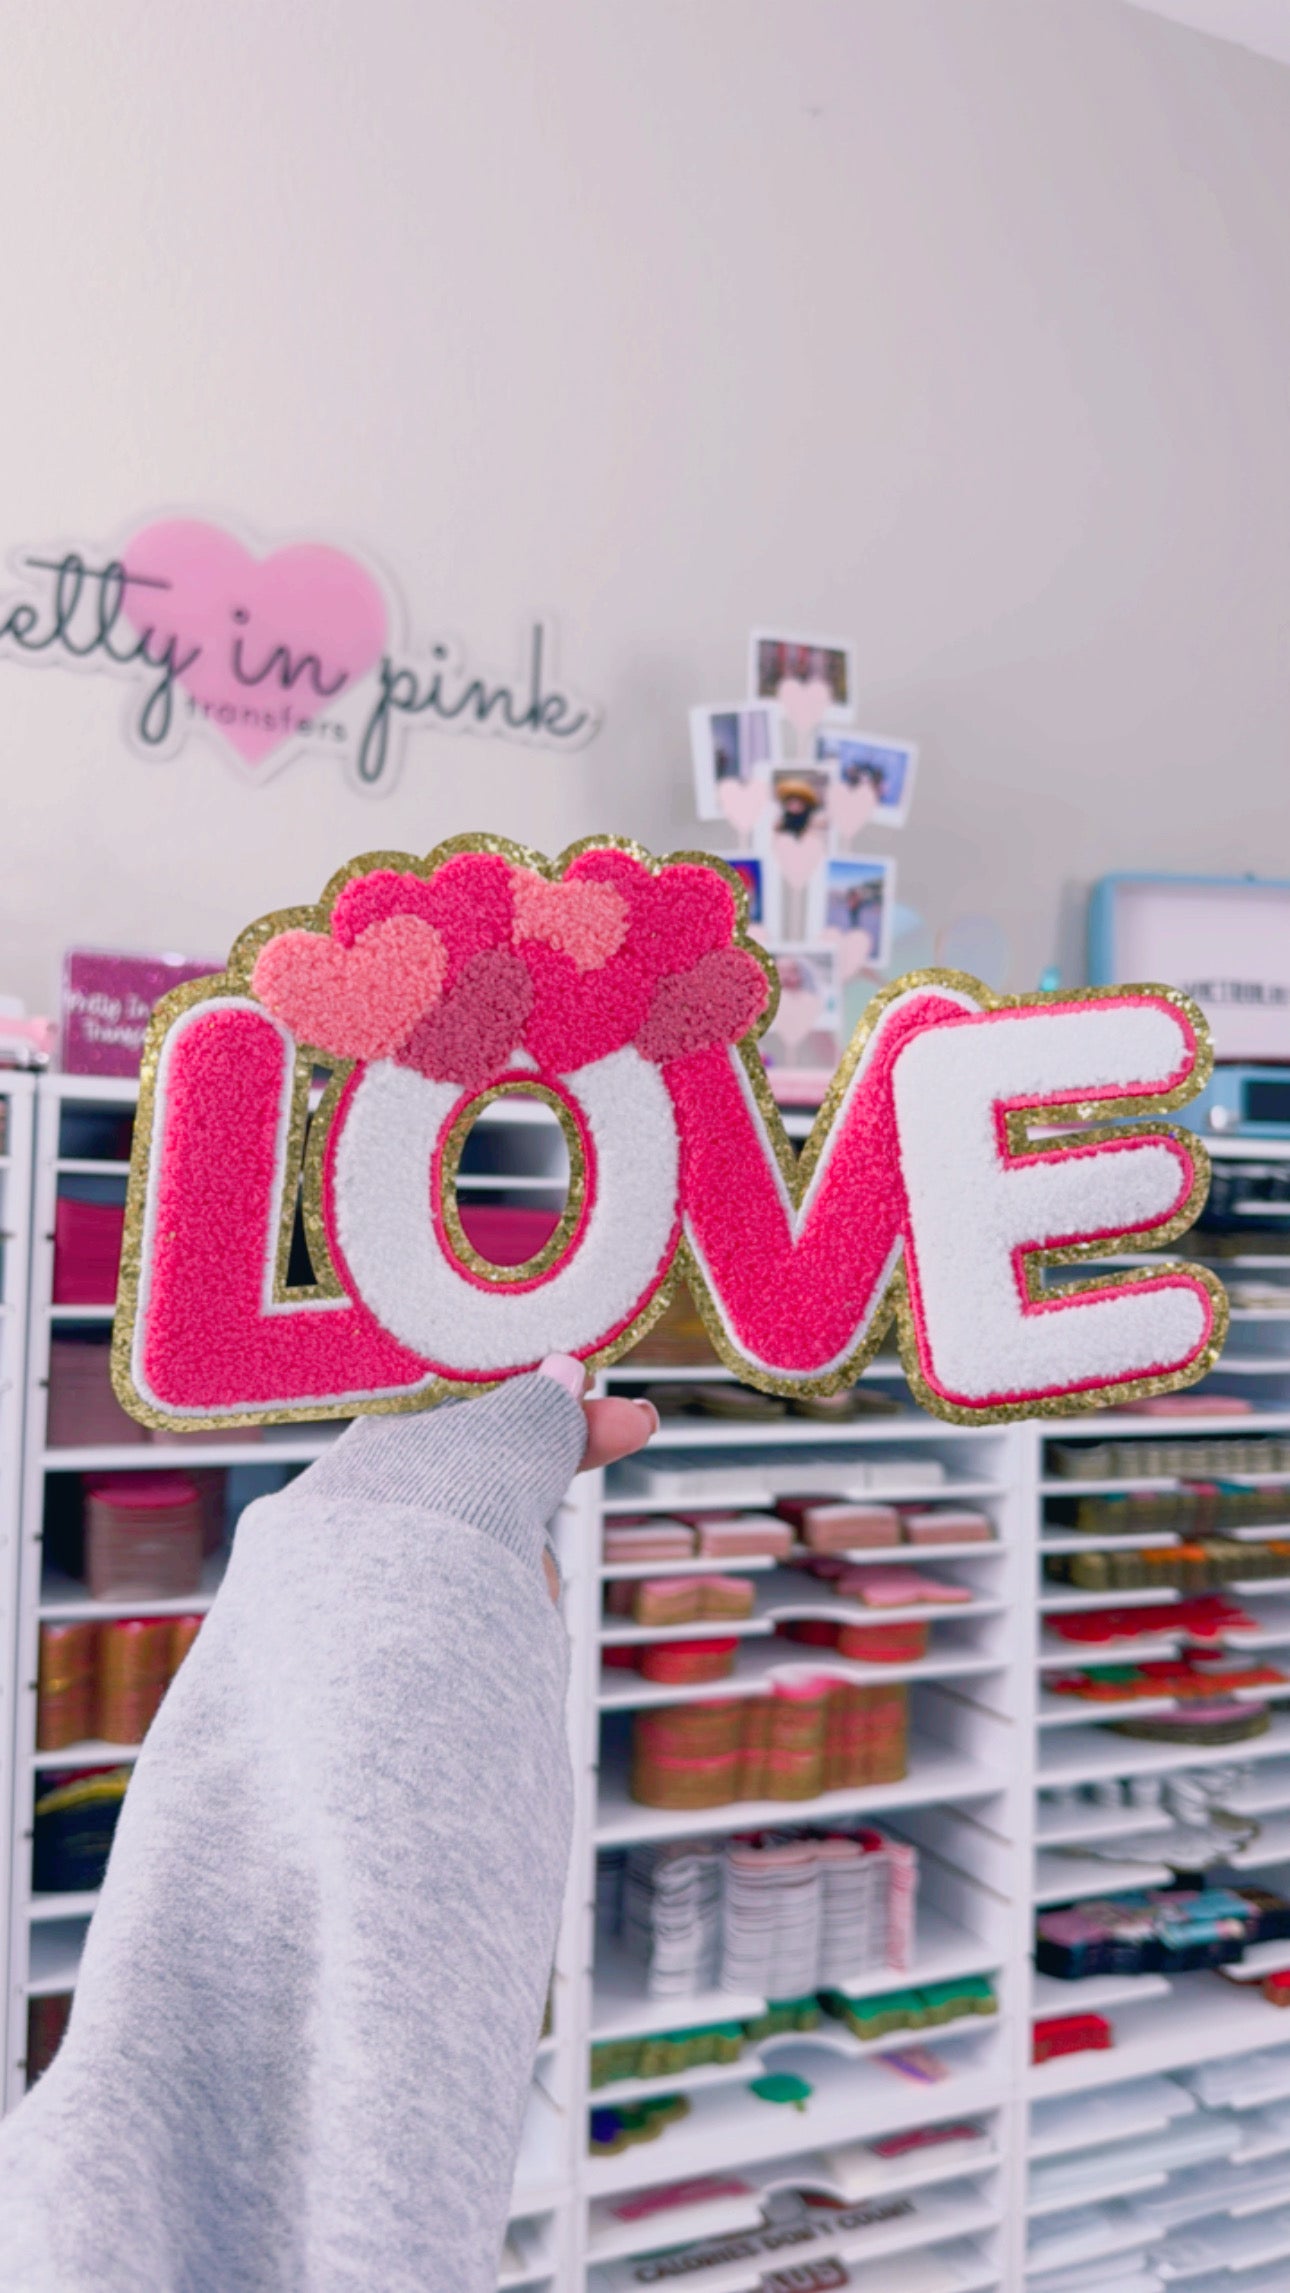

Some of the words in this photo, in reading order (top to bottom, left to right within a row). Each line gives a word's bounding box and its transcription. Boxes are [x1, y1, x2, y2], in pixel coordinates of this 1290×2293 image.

[187, 699, 347, 743] transfers
[232, 609, 347, 696] in
[359, 622, 588, 783] pink
[130, 983, 1214, 1410] LOVE
